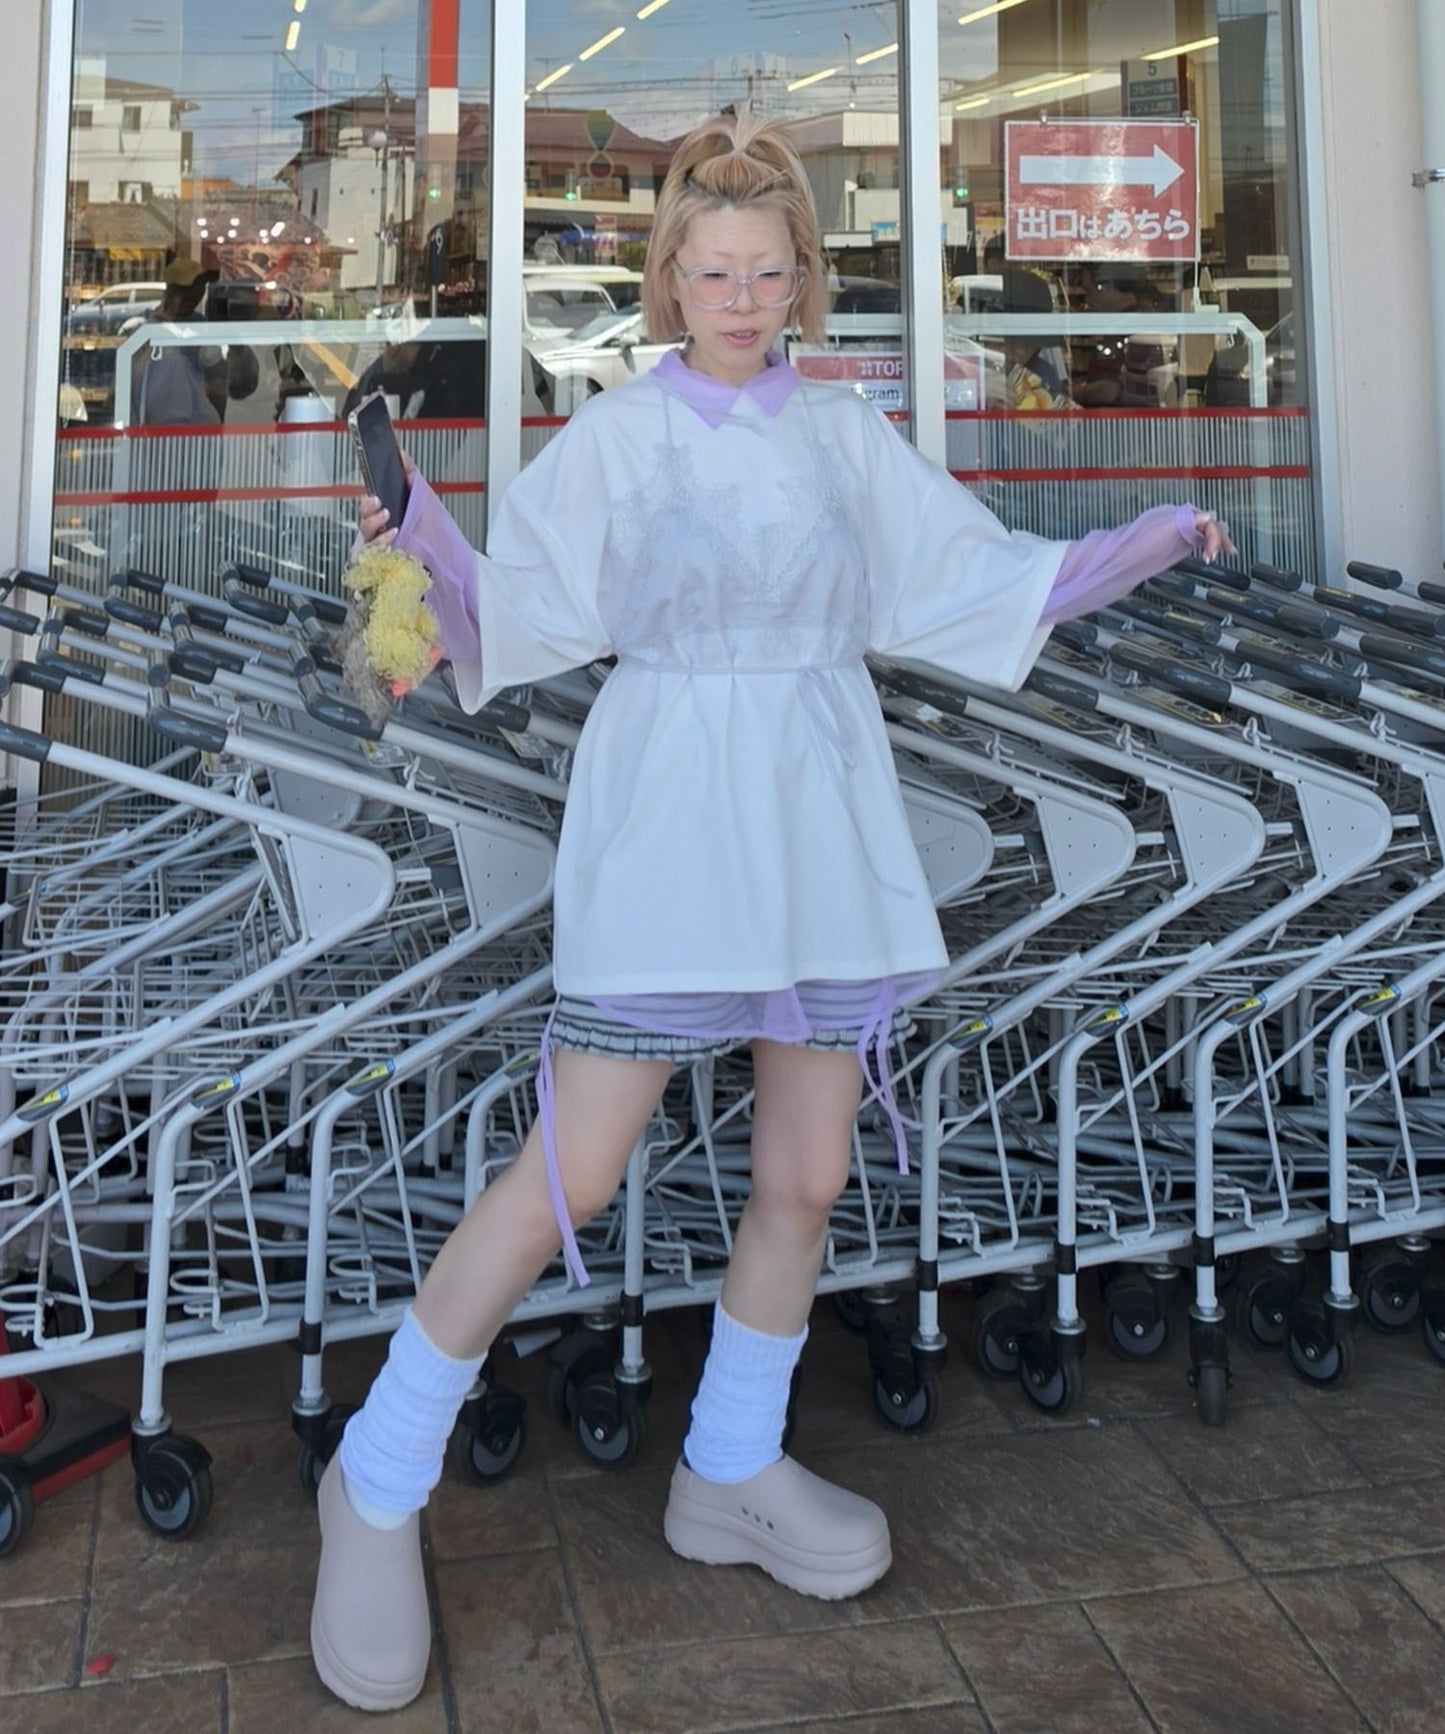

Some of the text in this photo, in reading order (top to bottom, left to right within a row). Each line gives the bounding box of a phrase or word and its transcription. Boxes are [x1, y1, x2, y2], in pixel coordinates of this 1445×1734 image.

[1148, 61, 1158, 76] 5
[1017, 206, 1190, 240] 出口はあちら
